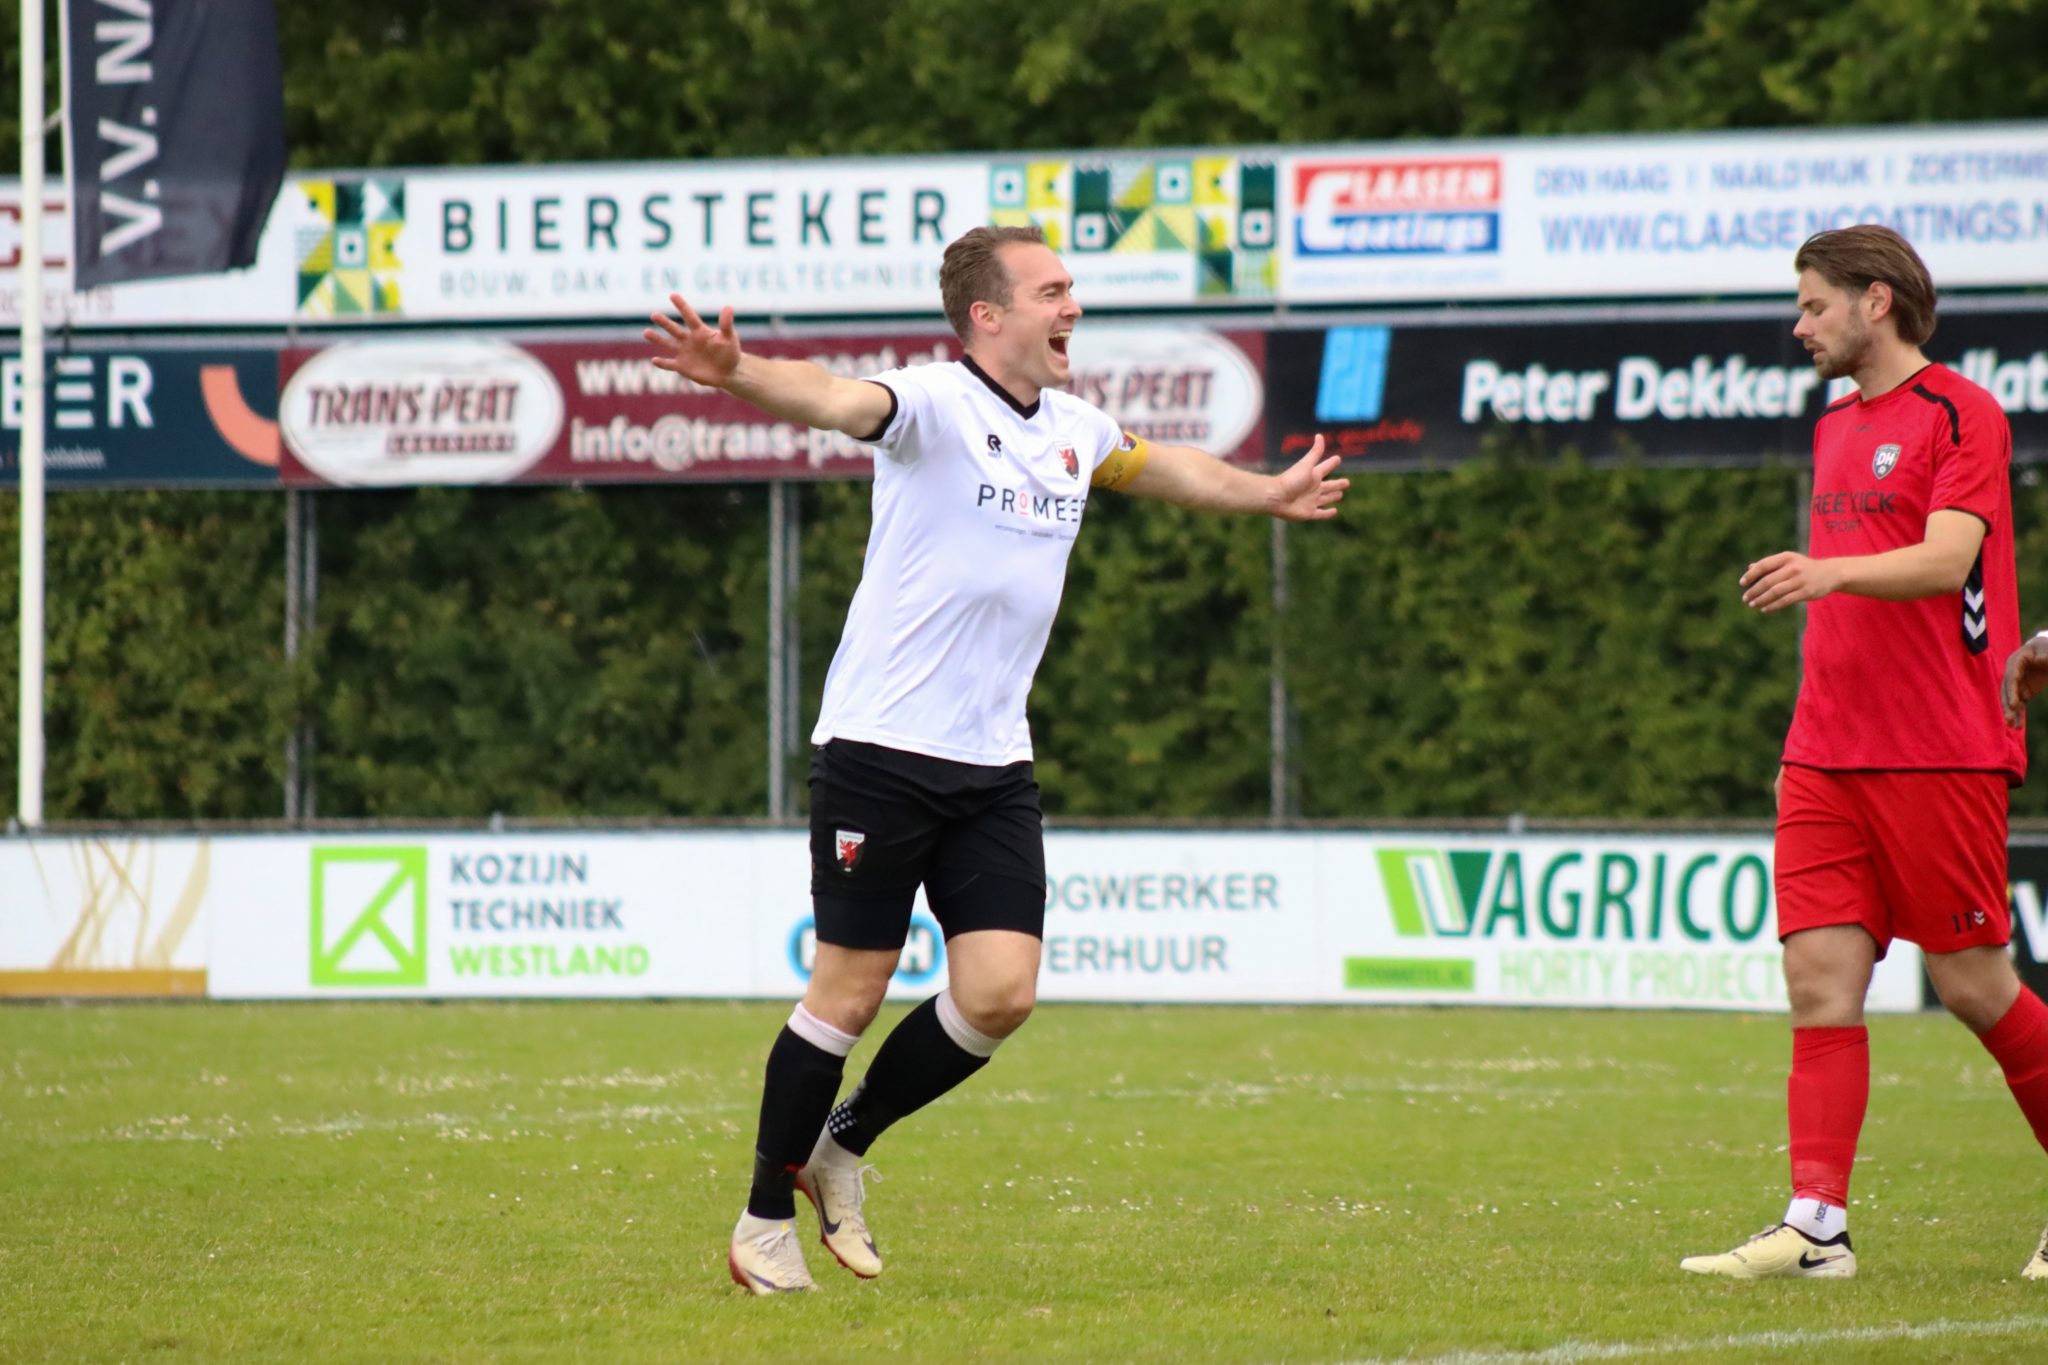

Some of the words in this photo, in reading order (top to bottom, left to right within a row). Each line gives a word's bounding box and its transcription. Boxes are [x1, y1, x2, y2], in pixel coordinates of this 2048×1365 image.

[1534, 165, 1588, 196] DEN
[1596, 162, 1671, 193] HAAG
[443, 188, 948, 253] BIERSTEKER
[642, 264, 681, 293] EN
[1462, 359, 1609, 422] Peter
[1616, 354, 1822, 420] Dekker
[1876, 451, 1896, 466] DH
[450, 853, 587, 885] KOZIJN
[450, 898, 625, 931] TECHNIEK
[1952, 911, 1973, 934] 11
[449, 945, 651, 977] WESTLAND
[1046, 934, 1229, 973] ERHUUR
[1500, 951, 1618, 998] HORTY
[1629, 951, 1785, 1002] PROJECT
